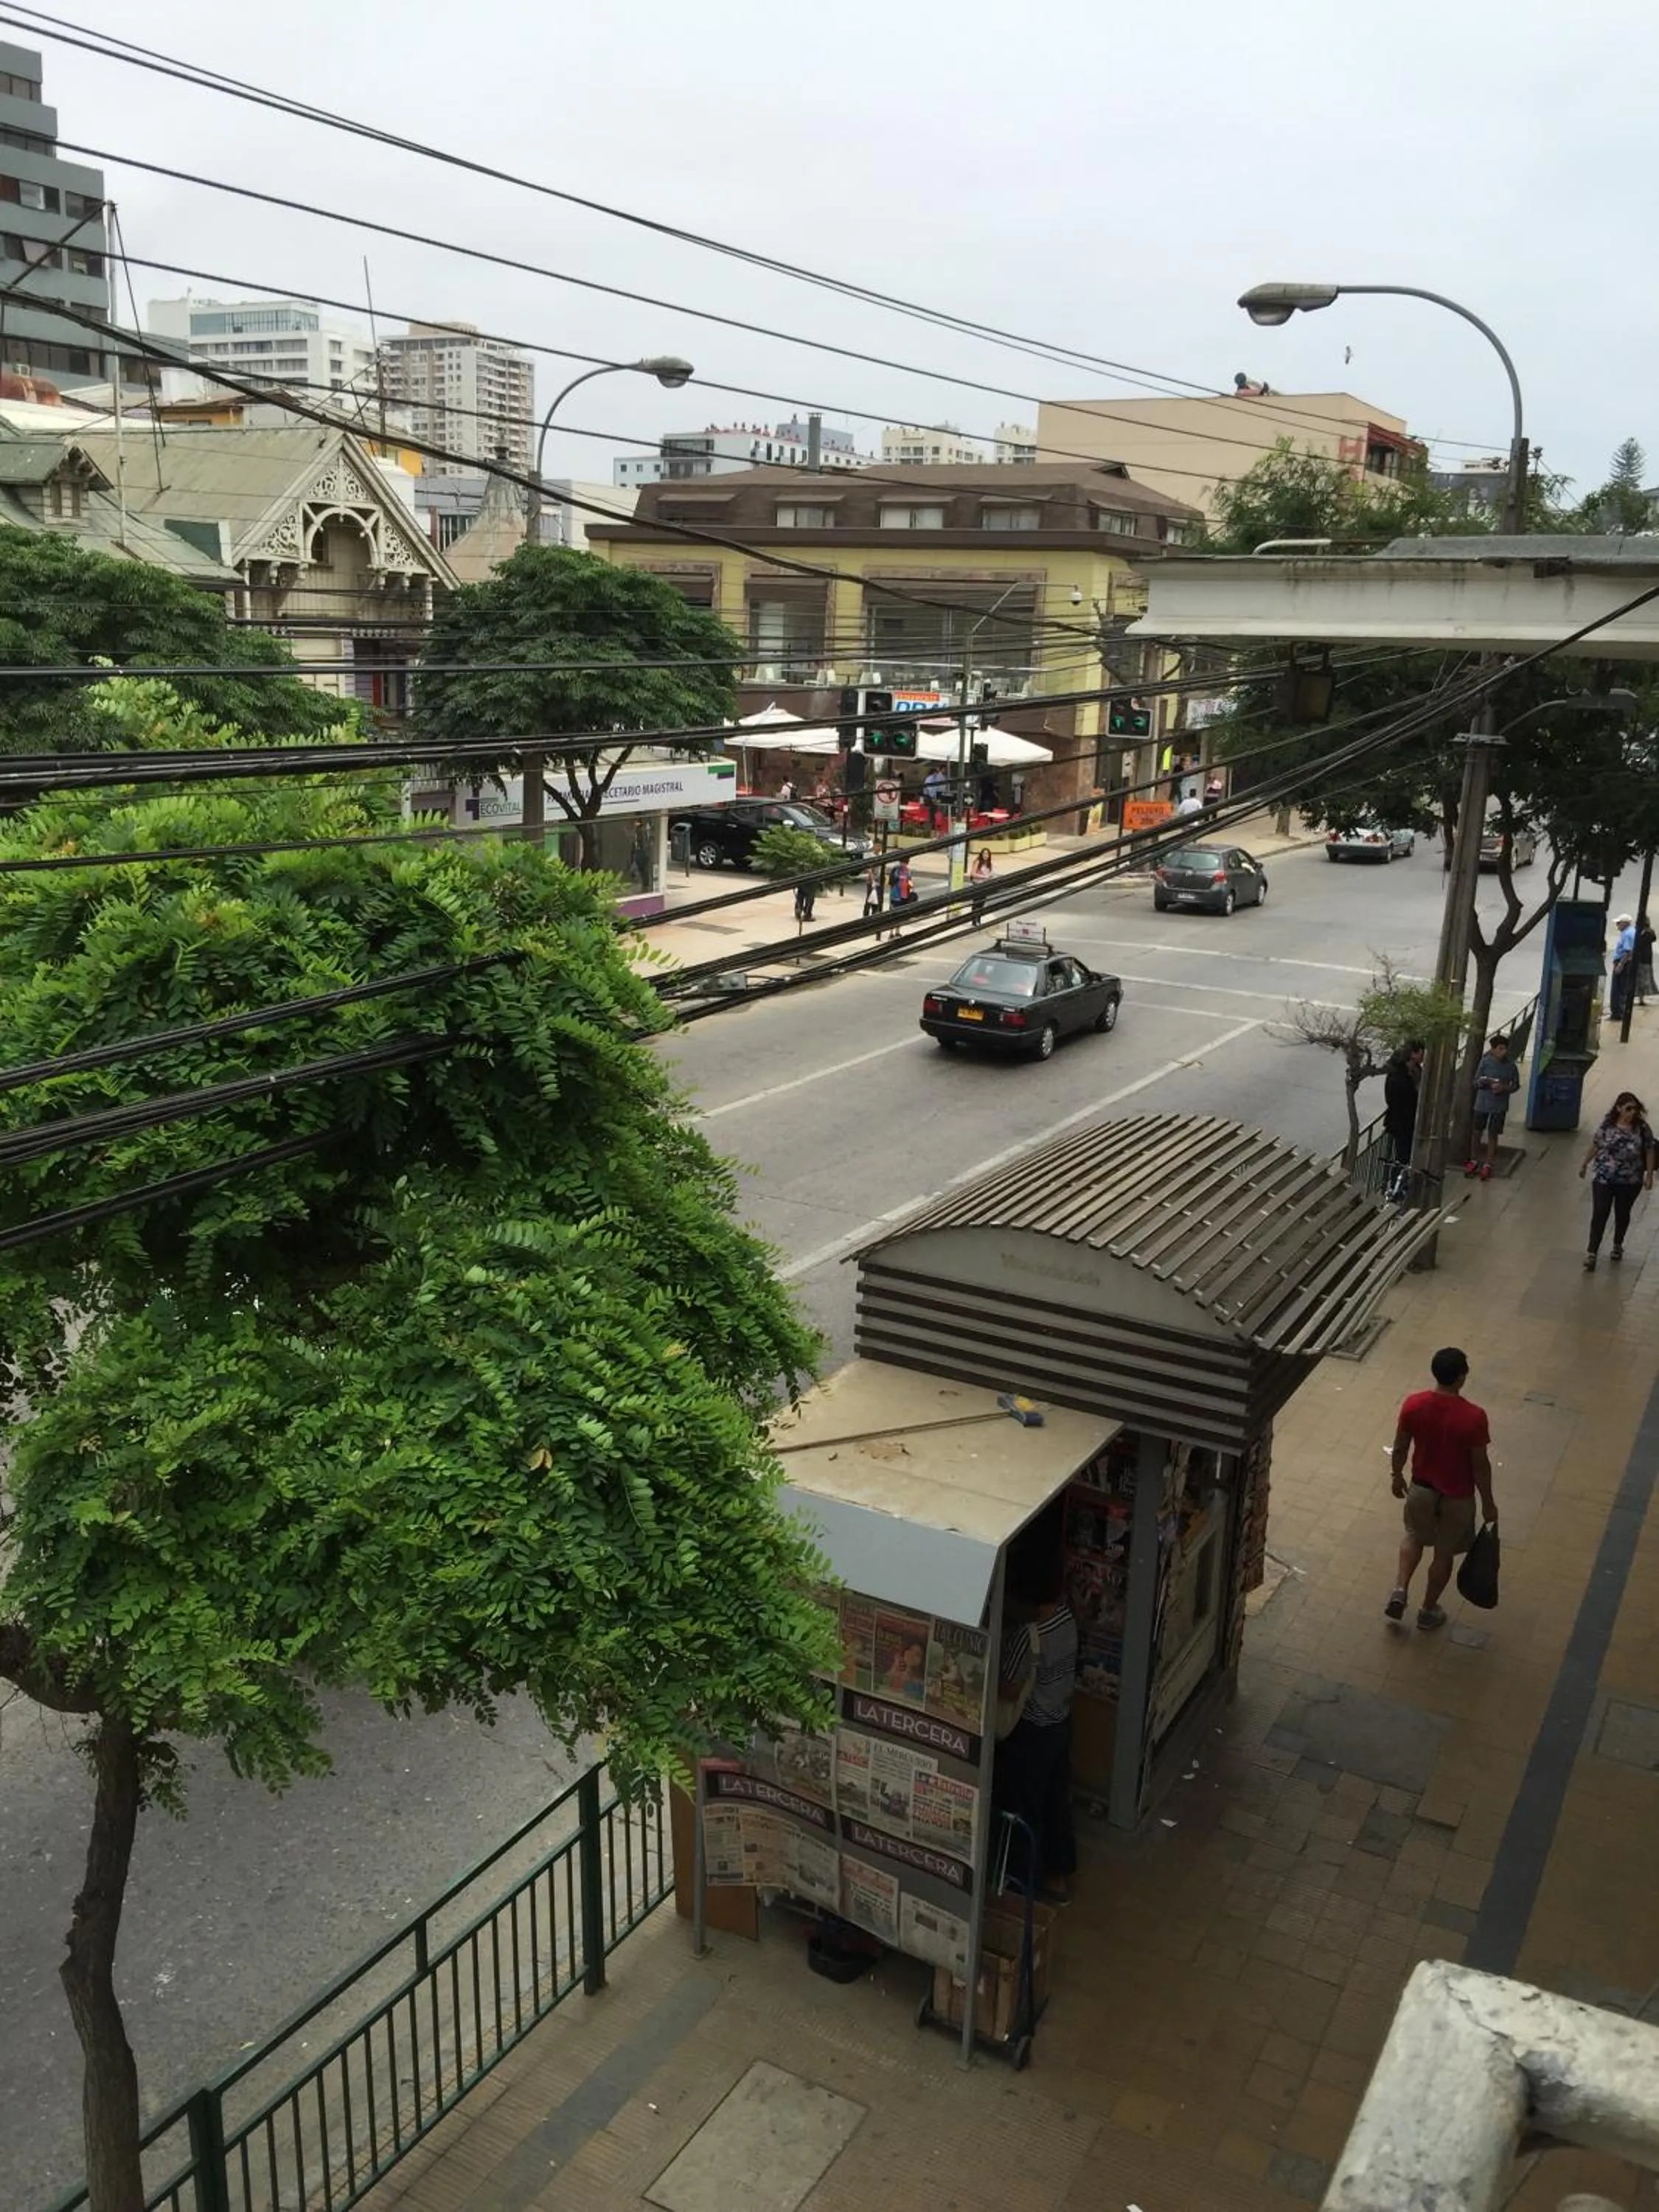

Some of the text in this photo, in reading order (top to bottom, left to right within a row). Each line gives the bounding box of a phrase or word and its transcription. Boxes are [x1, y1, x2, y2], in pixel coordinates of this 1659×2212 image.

[480, 801, 523, 815] ECOVITAL
[642, 781, 684, 795] MAGISTRAL
[857, 1700, 879, 1723] LA
[880, 1706, 966, 1754] TERCERA
[720, 1776, 744, 1793] LA
[744, 1779, 827, 1827] TERCERA
[854, 1826, 874, 1845] LA
[874, 1834, 960, 1879] TERCERA
